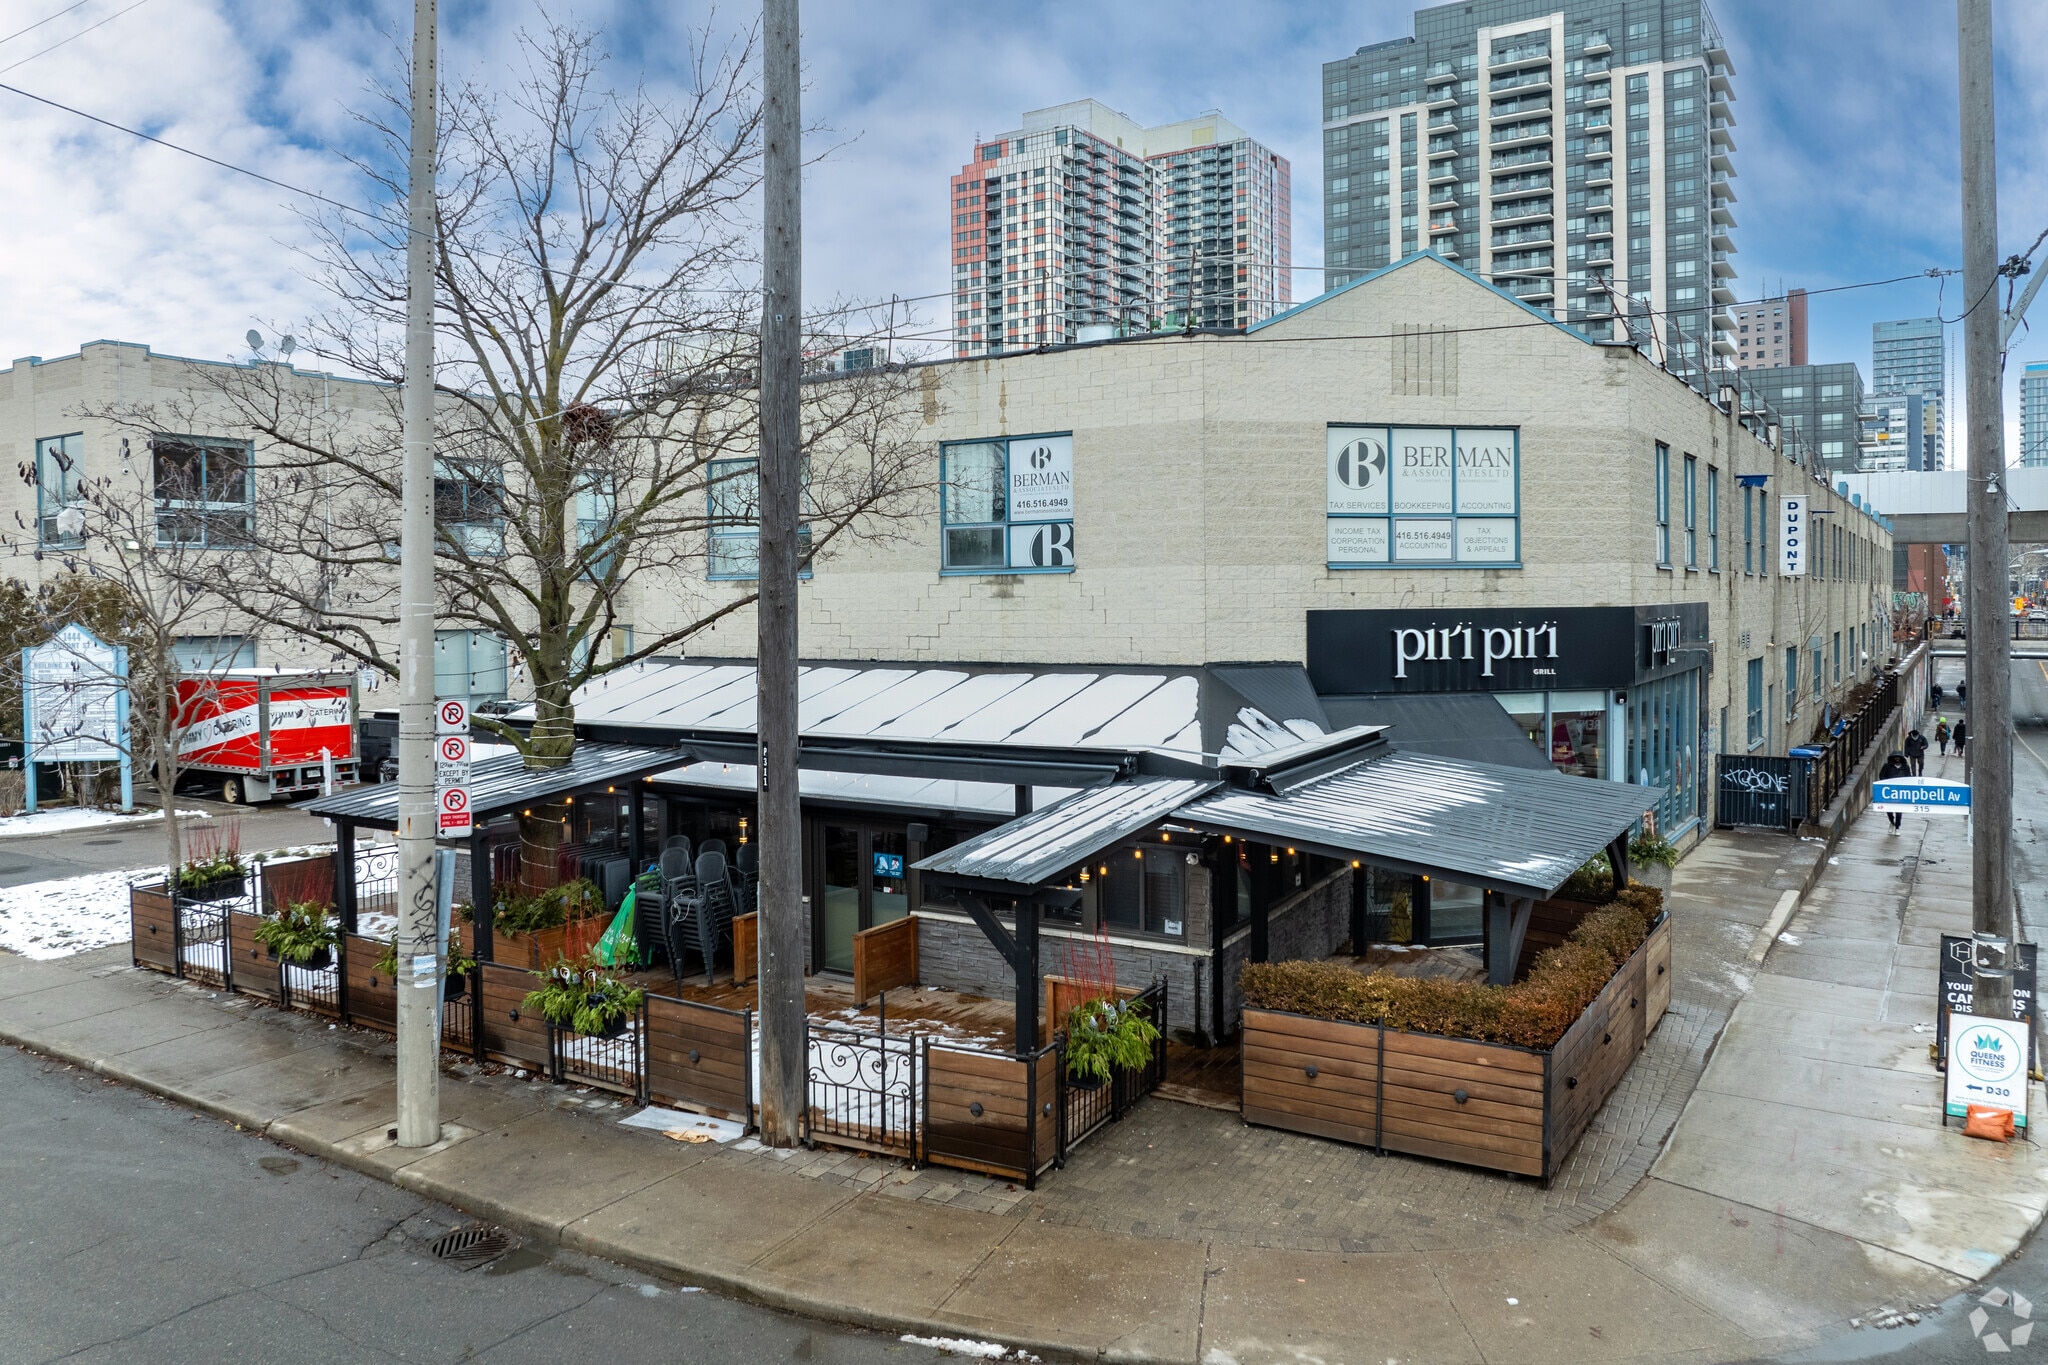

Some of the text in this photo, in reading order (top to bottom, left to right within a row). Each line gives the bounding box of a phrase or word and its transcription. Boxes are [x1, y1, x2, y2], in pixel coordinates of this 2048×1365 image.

[1403, 446, 1512, 467] BERMAN
[1402, 469, 1409, 477] &
[1013, 471, 1070, 487] BERMAN
[1016, 498, 1068, 508] 416.516.4949
[1394, 502, 1451, 510] BOOKKEEPING
[1461, 502, 1512, 510] ACCOUNTING
[1396, 531, 1451, 540] 416.516.4949
[1787, 501, 1799, 571] DUPONT
[63, 632, 81, 641] 1444
[1881, 786, 1961, 803] Campbell Av
[1970, 1051, 2006, 1061] QUEENS
[1970, 1057, 2005, 1068] FITNESS
[1986, 1086, 2010, 1097] D30
